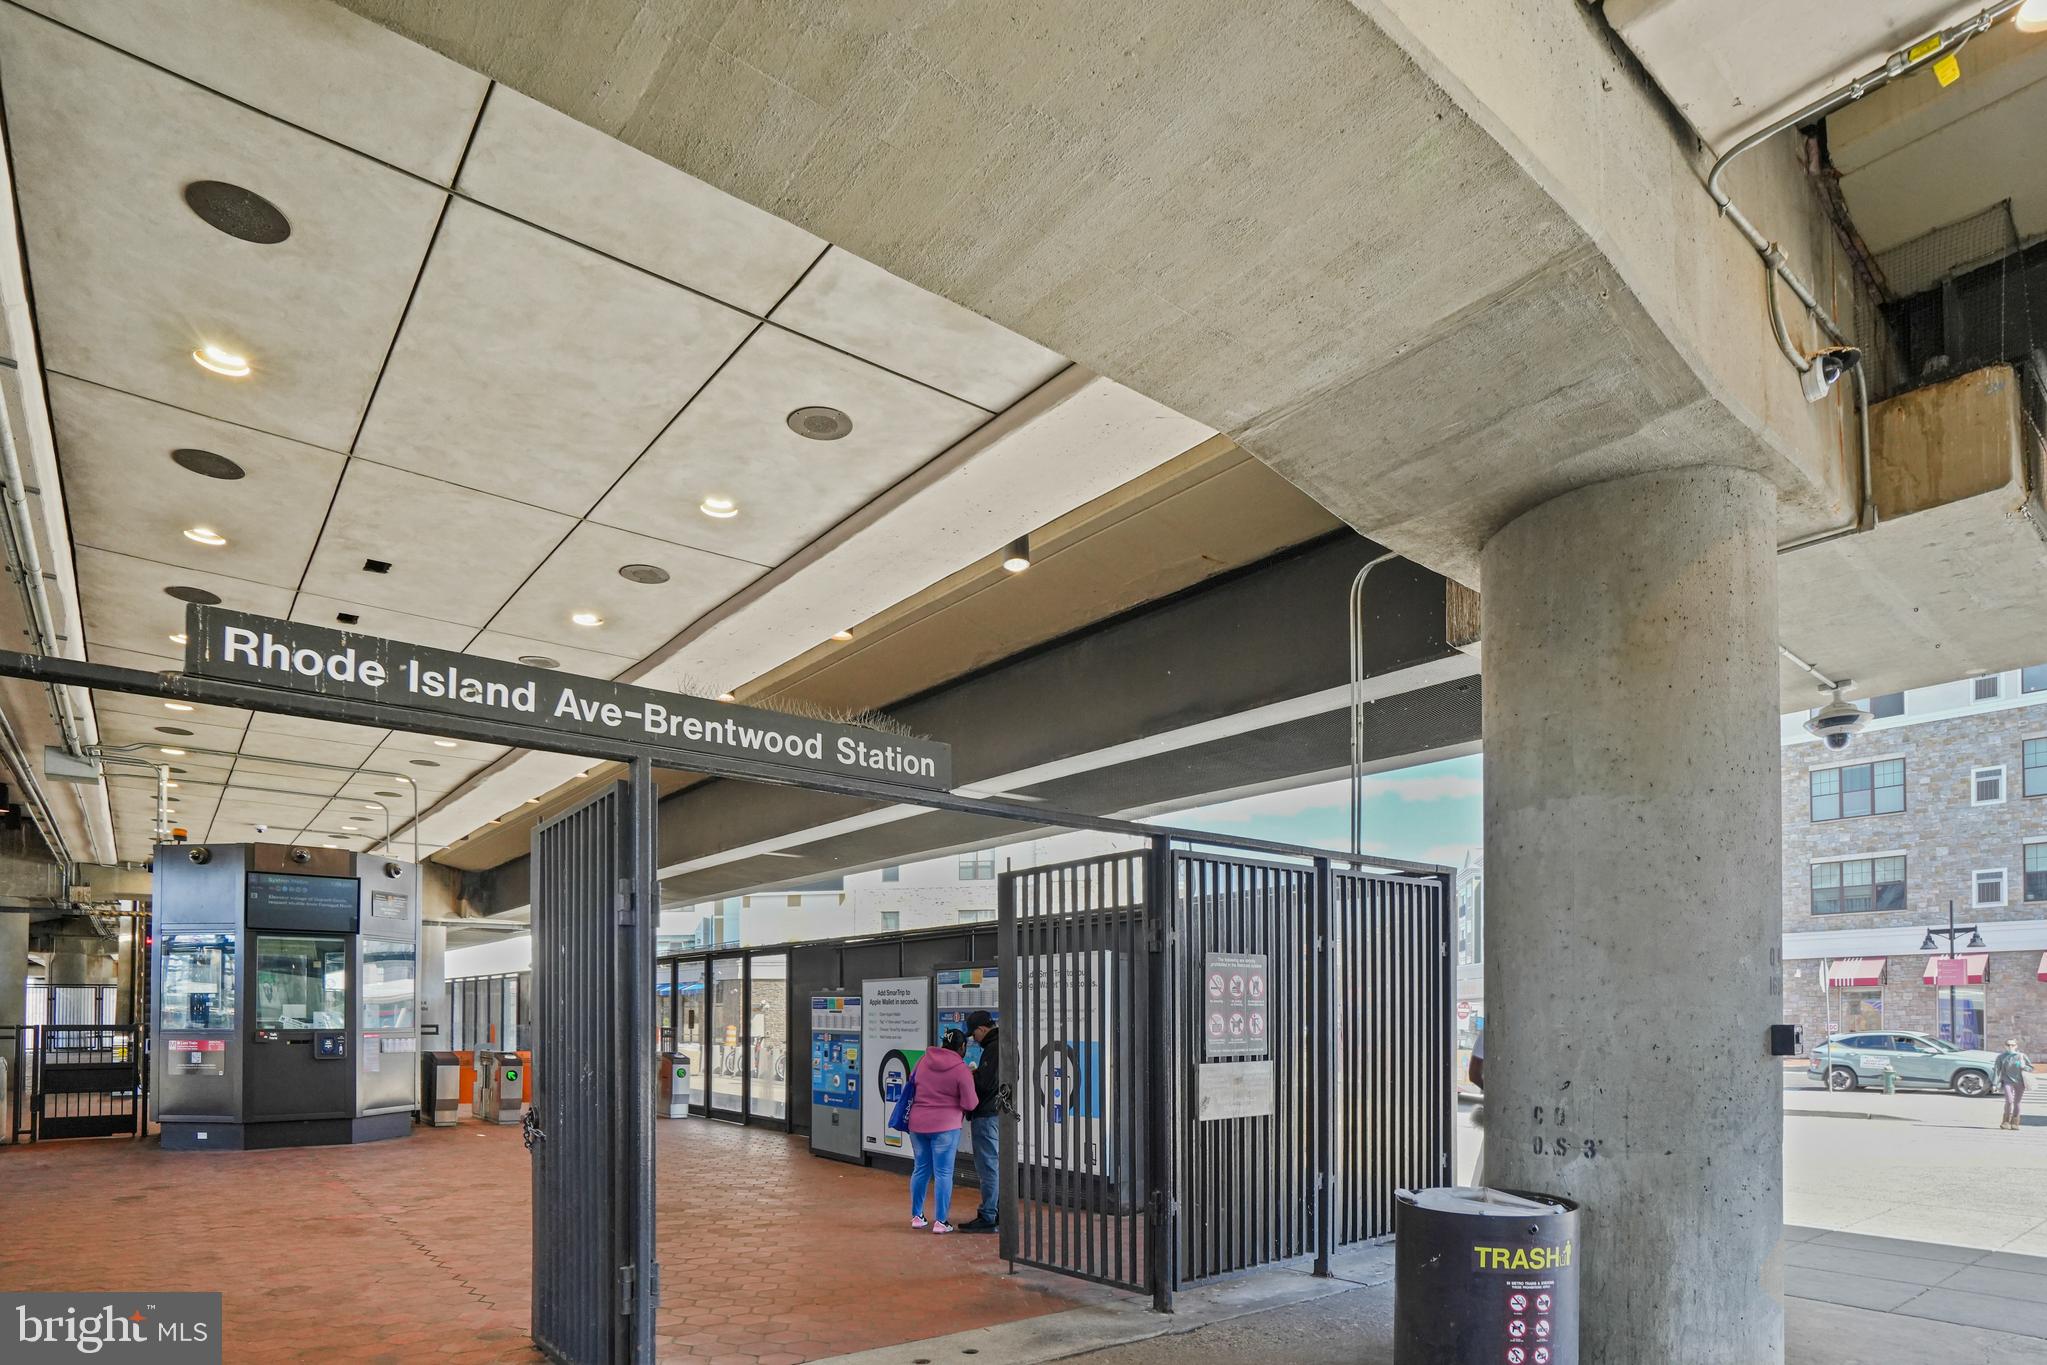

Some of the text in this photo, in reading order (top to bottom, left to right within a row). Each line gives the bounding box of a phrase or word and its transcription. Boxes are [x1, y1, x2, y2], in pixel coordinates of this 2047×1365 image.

[224, 625, 935, 778] Rhode Island Ave-Brentwood Station
[1474, 1246, 1560, 1270] TRASH
